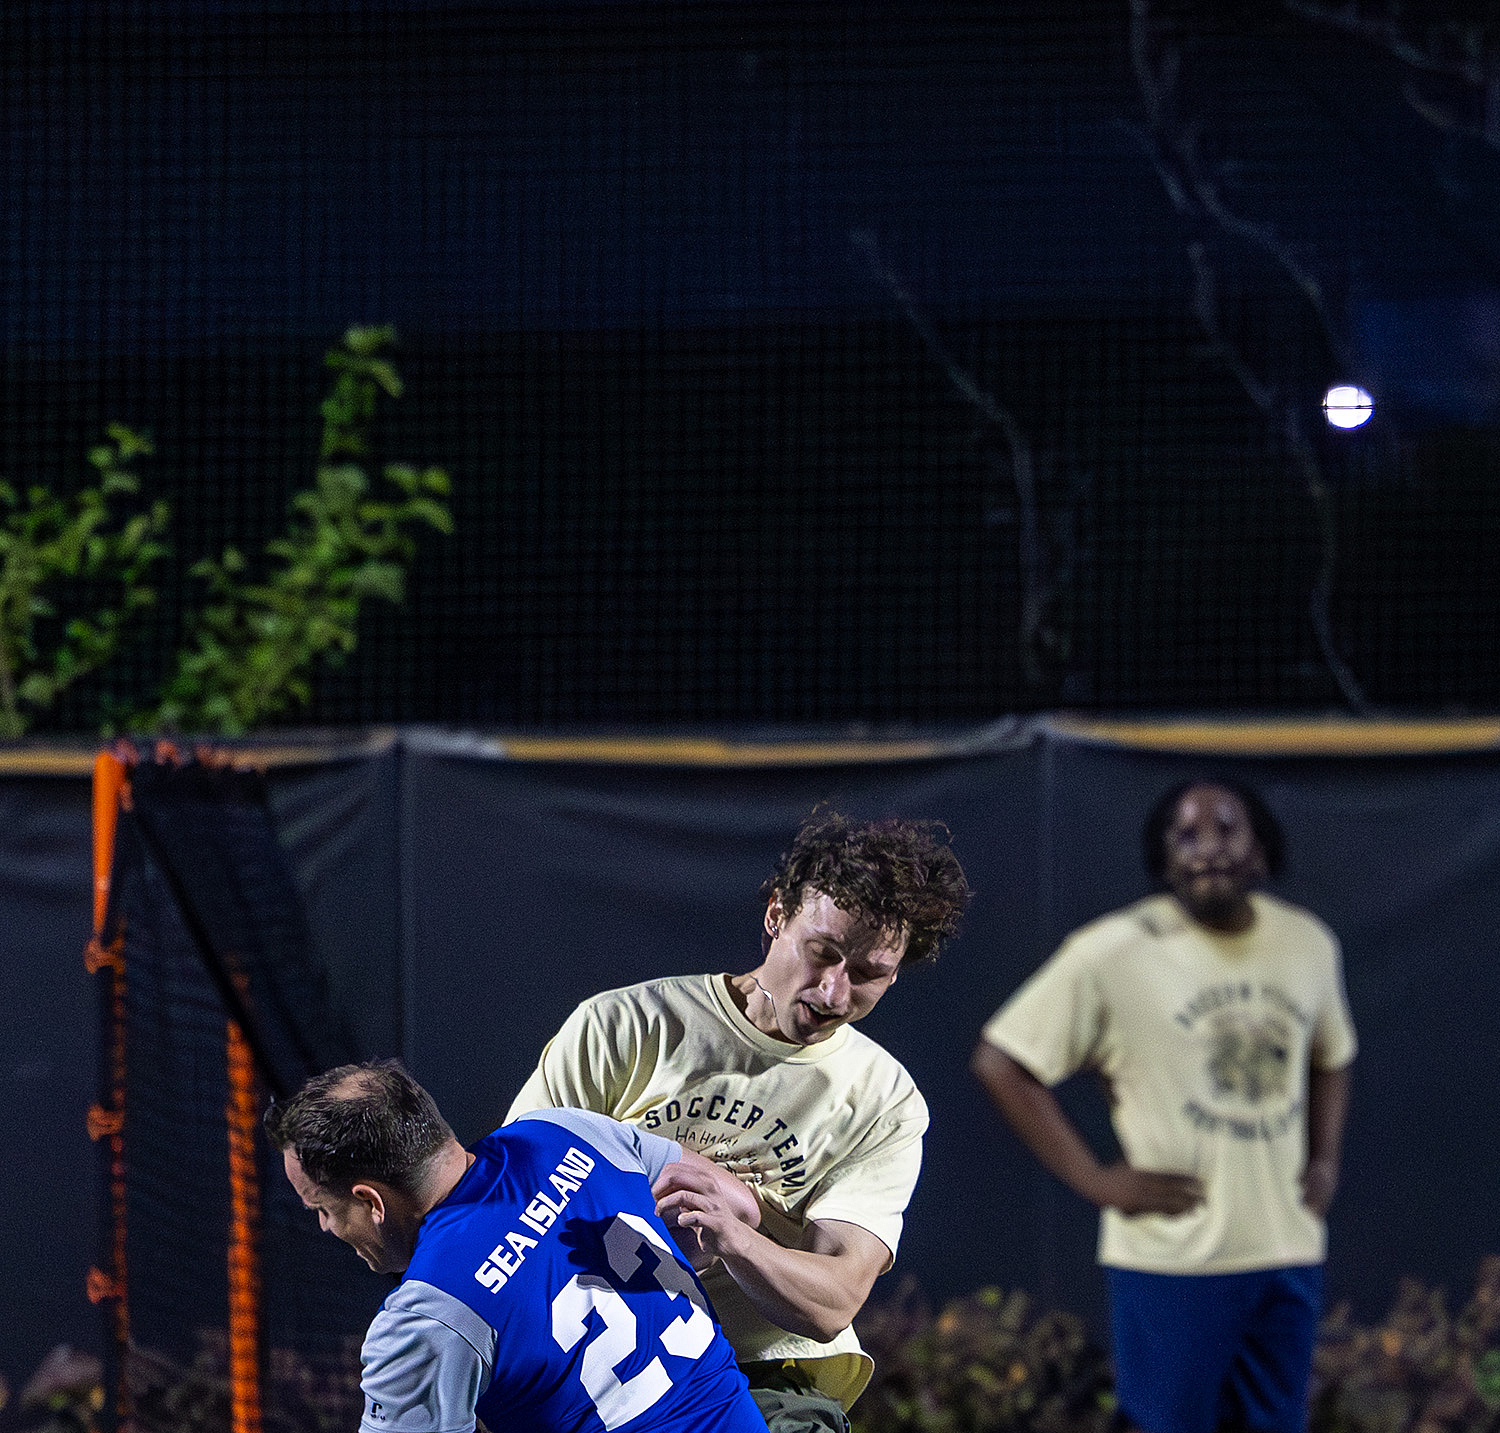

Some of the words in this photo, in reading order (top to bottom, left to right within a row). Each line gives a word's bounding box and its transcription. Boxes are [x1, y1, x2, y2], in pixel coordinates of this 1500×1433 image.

[645, 1095, 764, 1130] SOCCER
[763, 1118, 806, 1188] TEAM
[474, 1231, 539, 1295] SEA
[518, 1146, 596, 1237] ISLAND
[551, 1211, 716, 1432] 23
